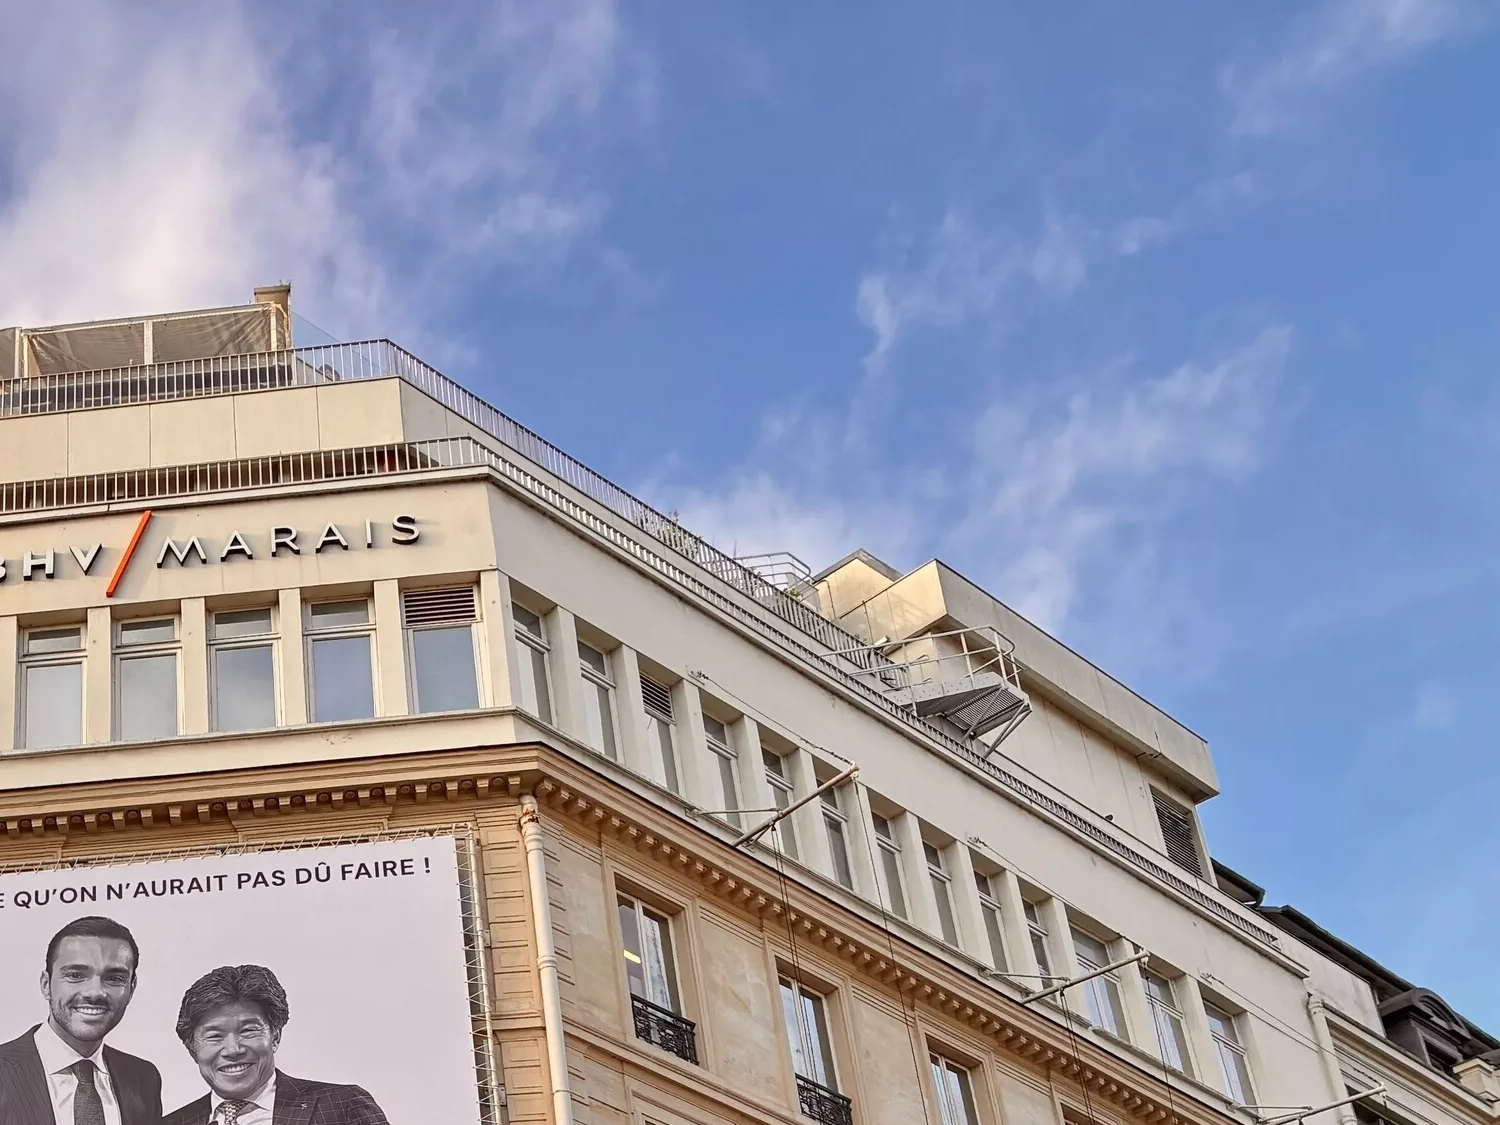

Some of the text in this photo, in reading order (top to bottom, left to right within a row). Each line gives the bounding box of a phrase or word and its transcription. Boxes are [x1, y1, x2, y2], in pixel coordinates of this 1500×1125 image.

[237, 869, 286, 890] PAS
[295, 861, 331, 885] DÛ
[340, 858, 415, 881] FAIRE
